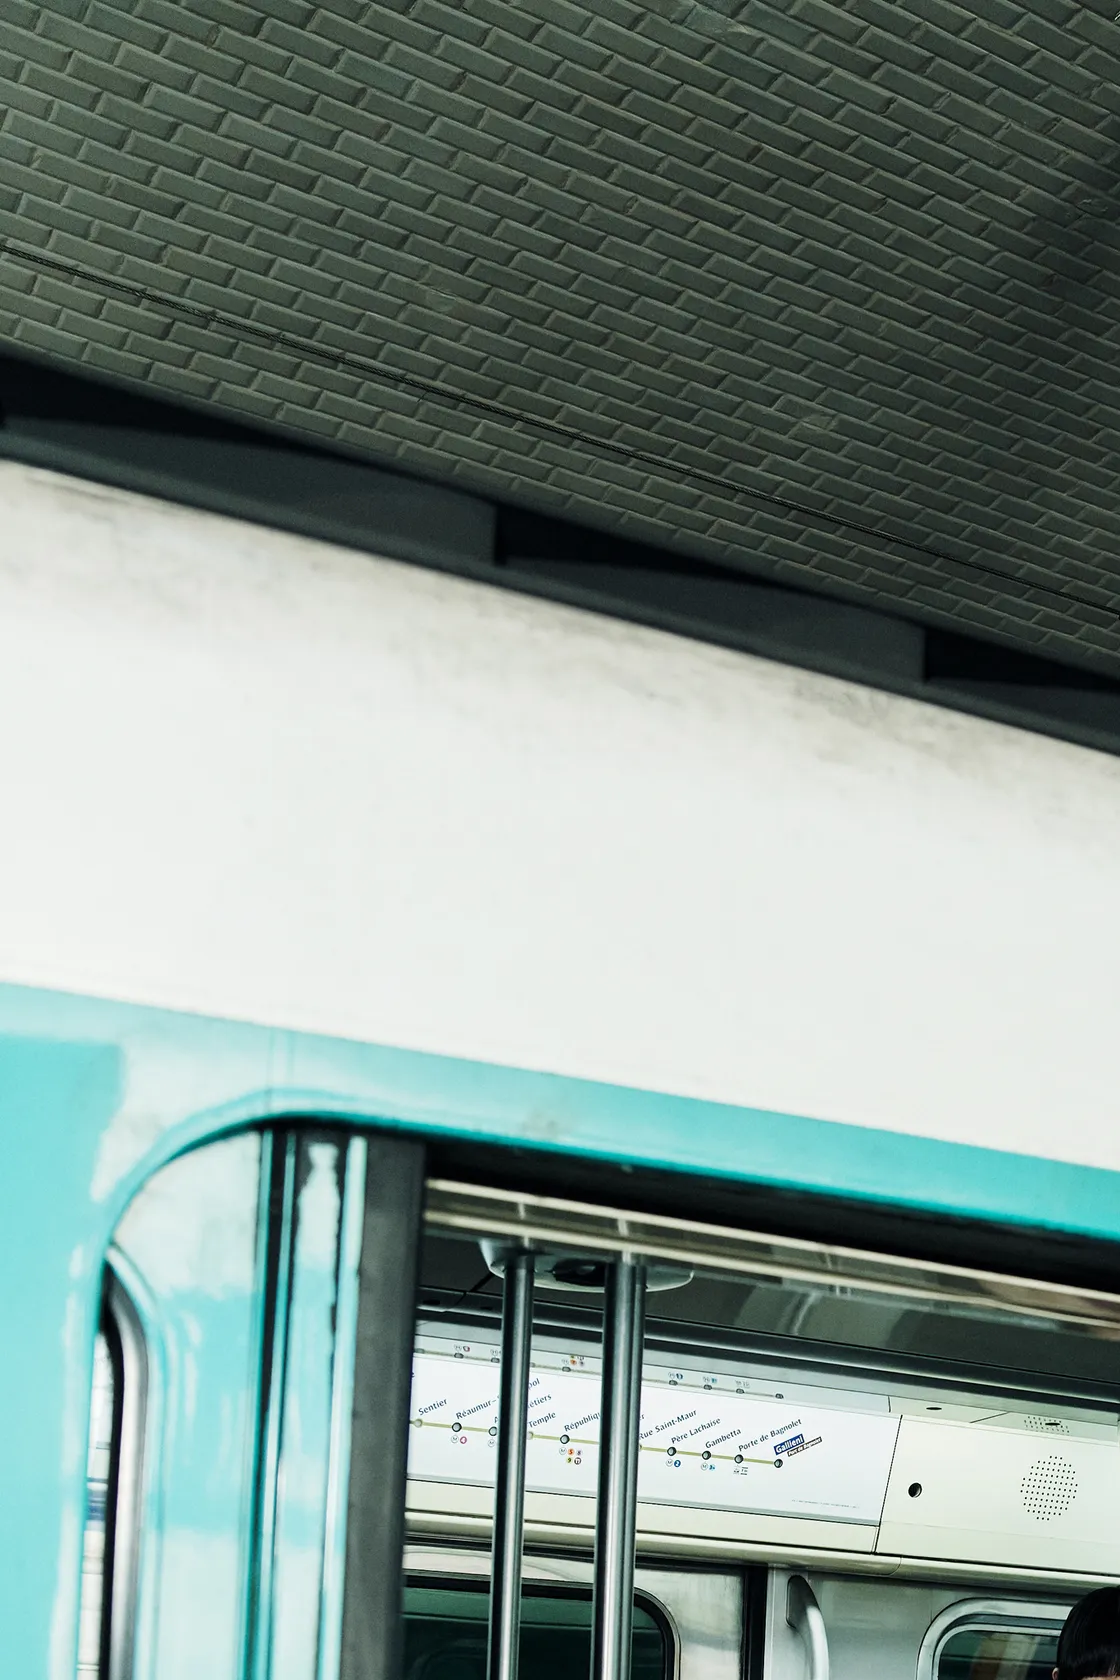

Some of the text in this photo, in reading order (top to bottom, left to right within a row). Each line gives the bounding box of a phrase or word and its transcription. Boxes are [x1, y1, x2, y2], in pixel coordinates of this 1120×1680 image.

[418, 1398, 448, 1416] Sentier
[528, 1393, 552, 1409] étiers
[528, 1412, 557, 1428] Temple
[639, 1409, 698, 1441] Rue Saint-Maur
[671, 1417, 722, 1445] Père Lachaise
[704, 1428, 742, 1449] Gambetta
[738, 1418, 803, 1453] Porte de Bagnolet
[775, 1435, 804, 1454] Gallieni
